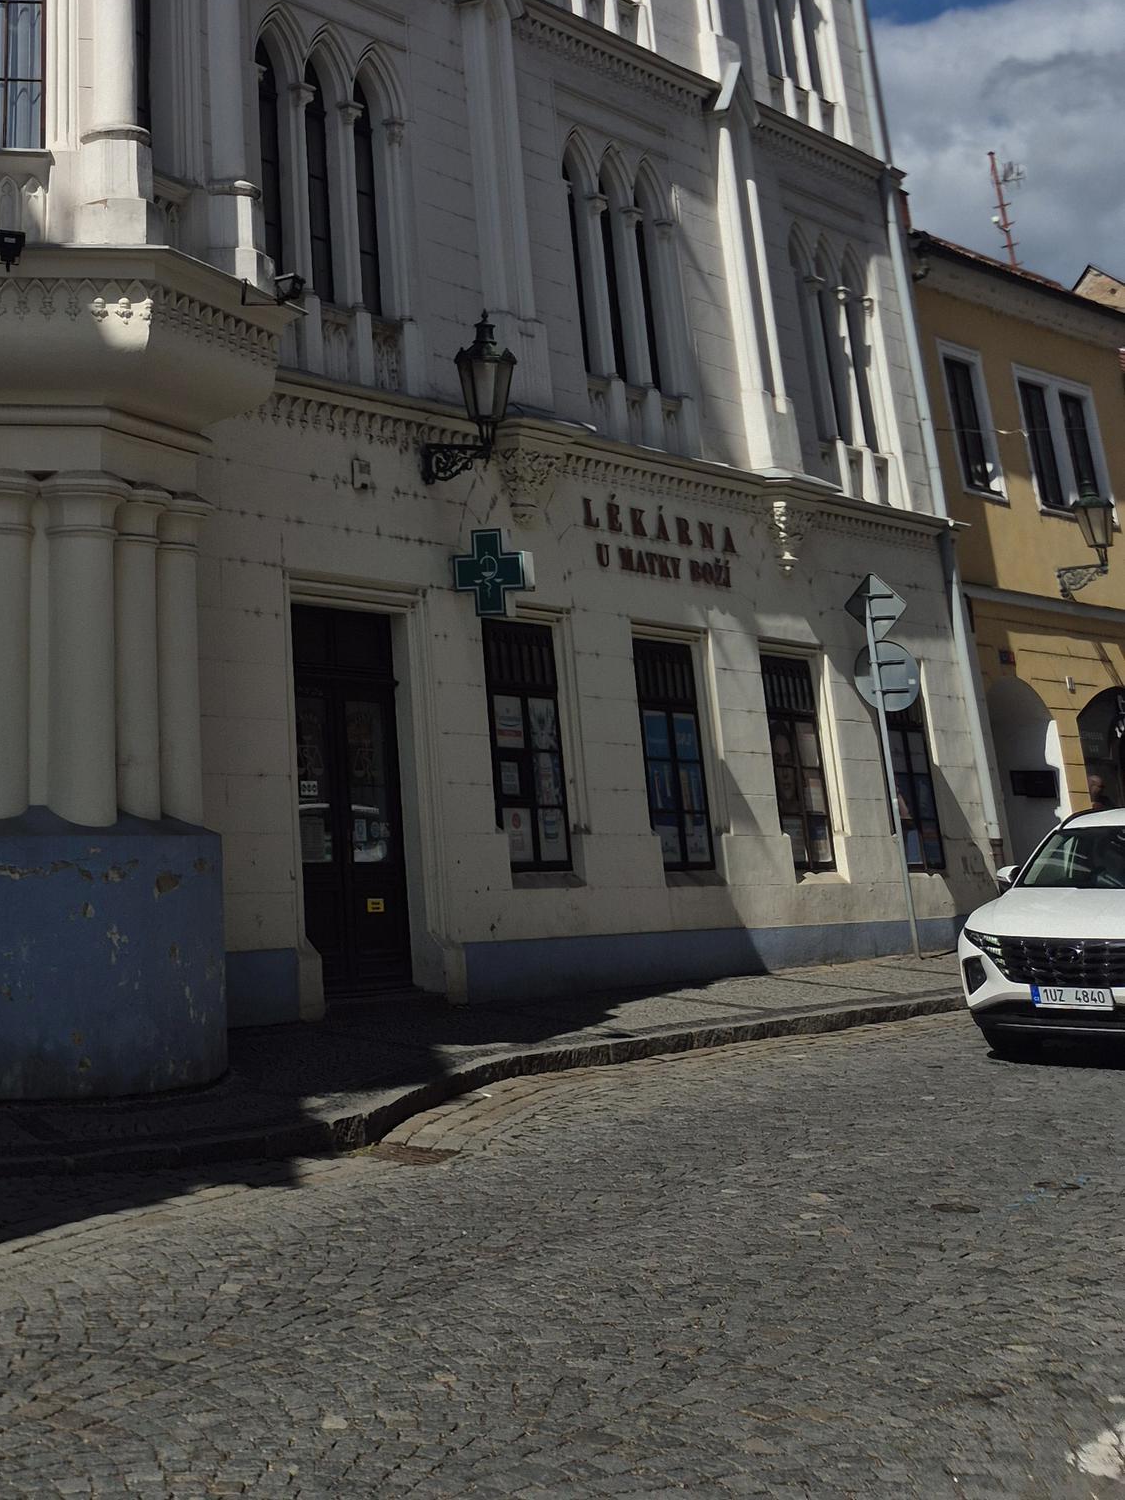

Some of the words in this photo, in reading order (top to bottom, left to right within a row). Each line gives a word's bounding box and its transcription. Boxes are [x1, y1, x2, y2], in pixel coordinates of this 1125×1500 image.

[583, 493, 737, 553] LÉKÁRNA
[596, 543, 610, 568] U
[618, 547, 681, 579] MATKY
[689, 557, 732, 588] BOŽÍ
[1043, 988, 1065, 1002] 1UZ
[1075, 989, 1105, 1003] 4840
